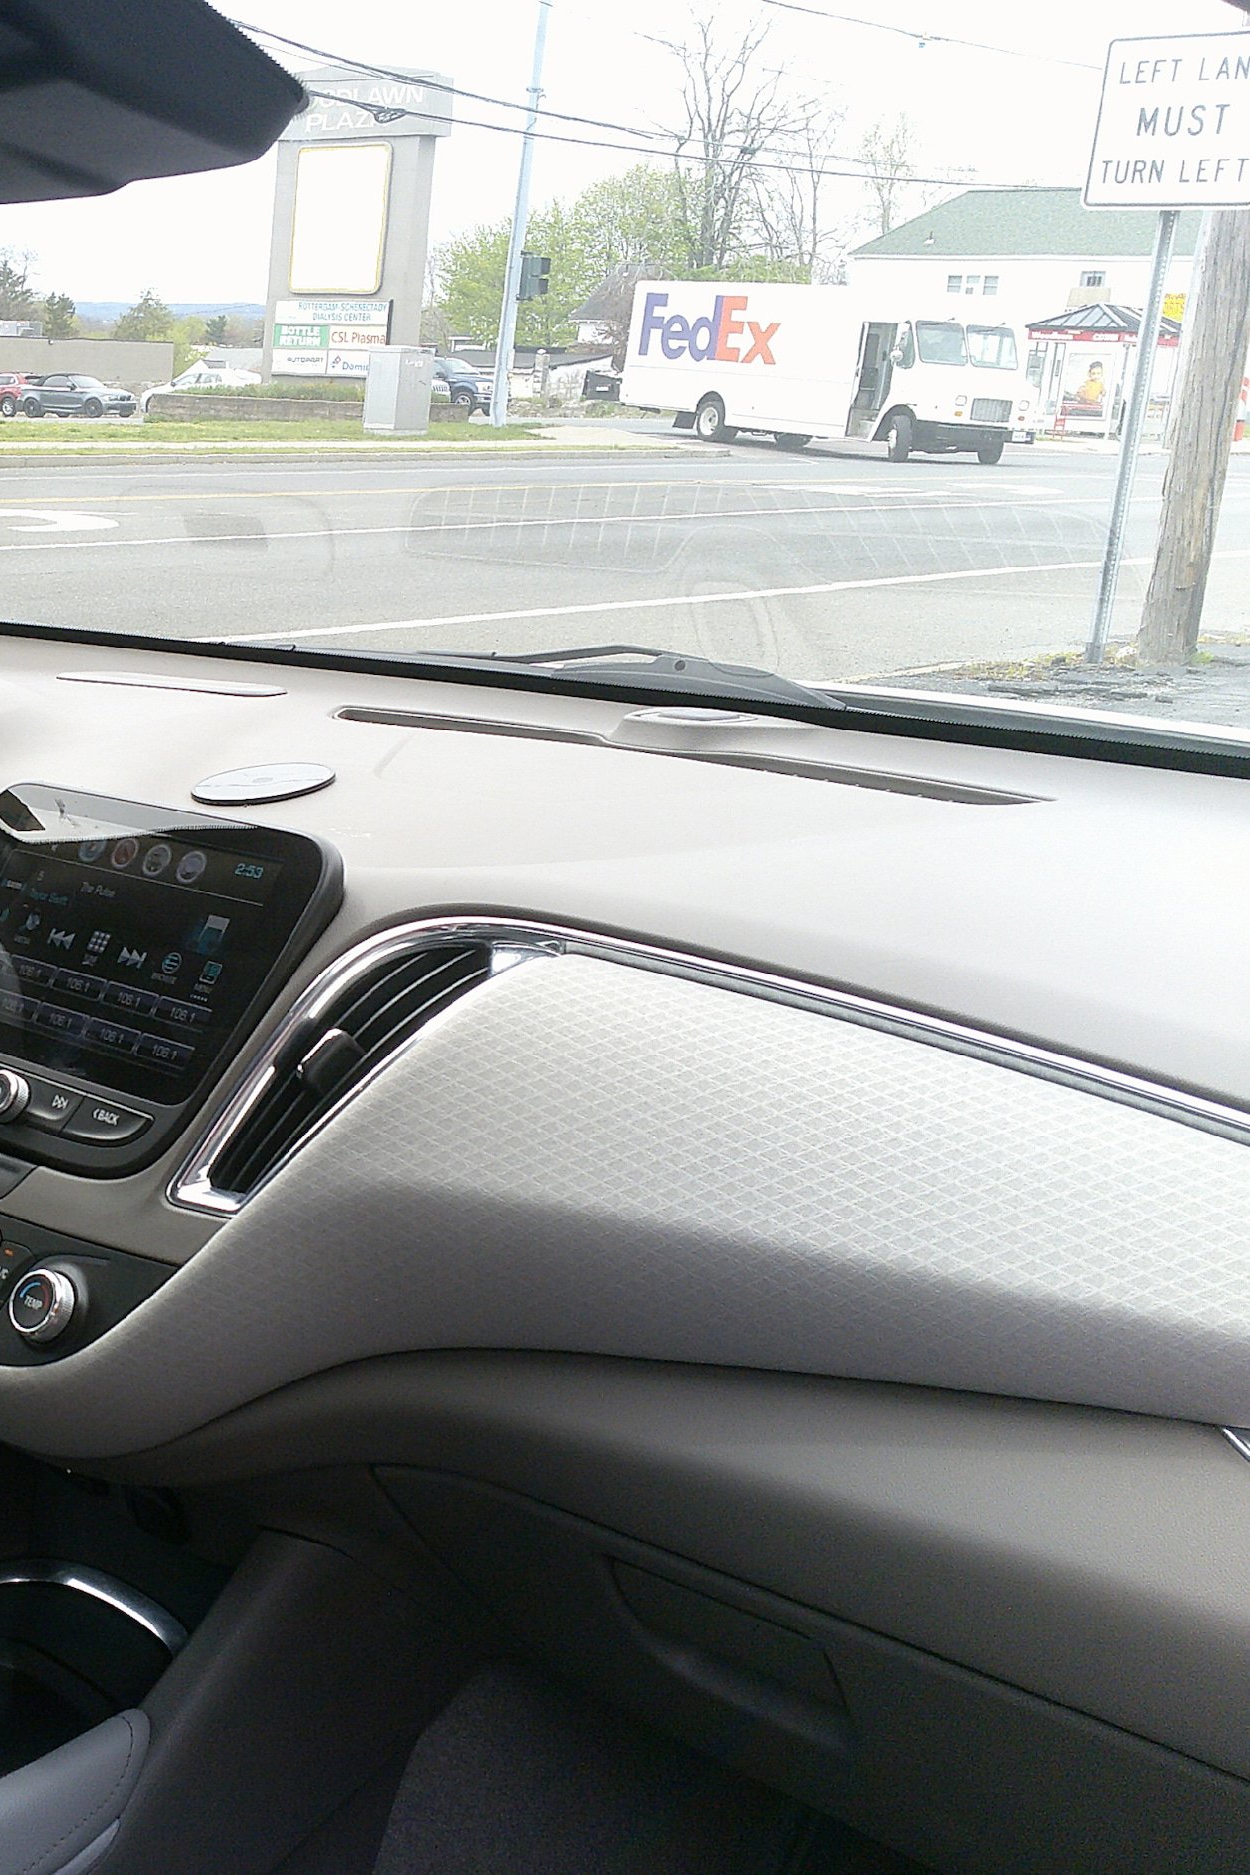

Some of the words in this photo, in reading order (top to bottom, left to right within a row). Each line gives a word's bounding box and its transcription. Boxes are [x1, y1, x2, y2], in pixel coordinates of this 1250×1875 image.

[1119, 58, 1183, 85] LEFT
[1135, 103, 1231, 137] MUST
[1101, 159, 1166, 184] TURN
[1178, 157, 1250, 183] LEFT
[312, 312, 343, 322] DIALYSIS
[343, 312, 372, 322] CENTER
[281, 325, 321, 335] BOTTLE
[637, 292, 782, 366] FedEx
[279, 335, 321, 346] RETURN
[330, 331, 349, 343] CSL
[351, 332, 386, 345] Plasma
[233, 862, 265, 879] 2:53
[23, 1294, 44, 1311] TEMP
